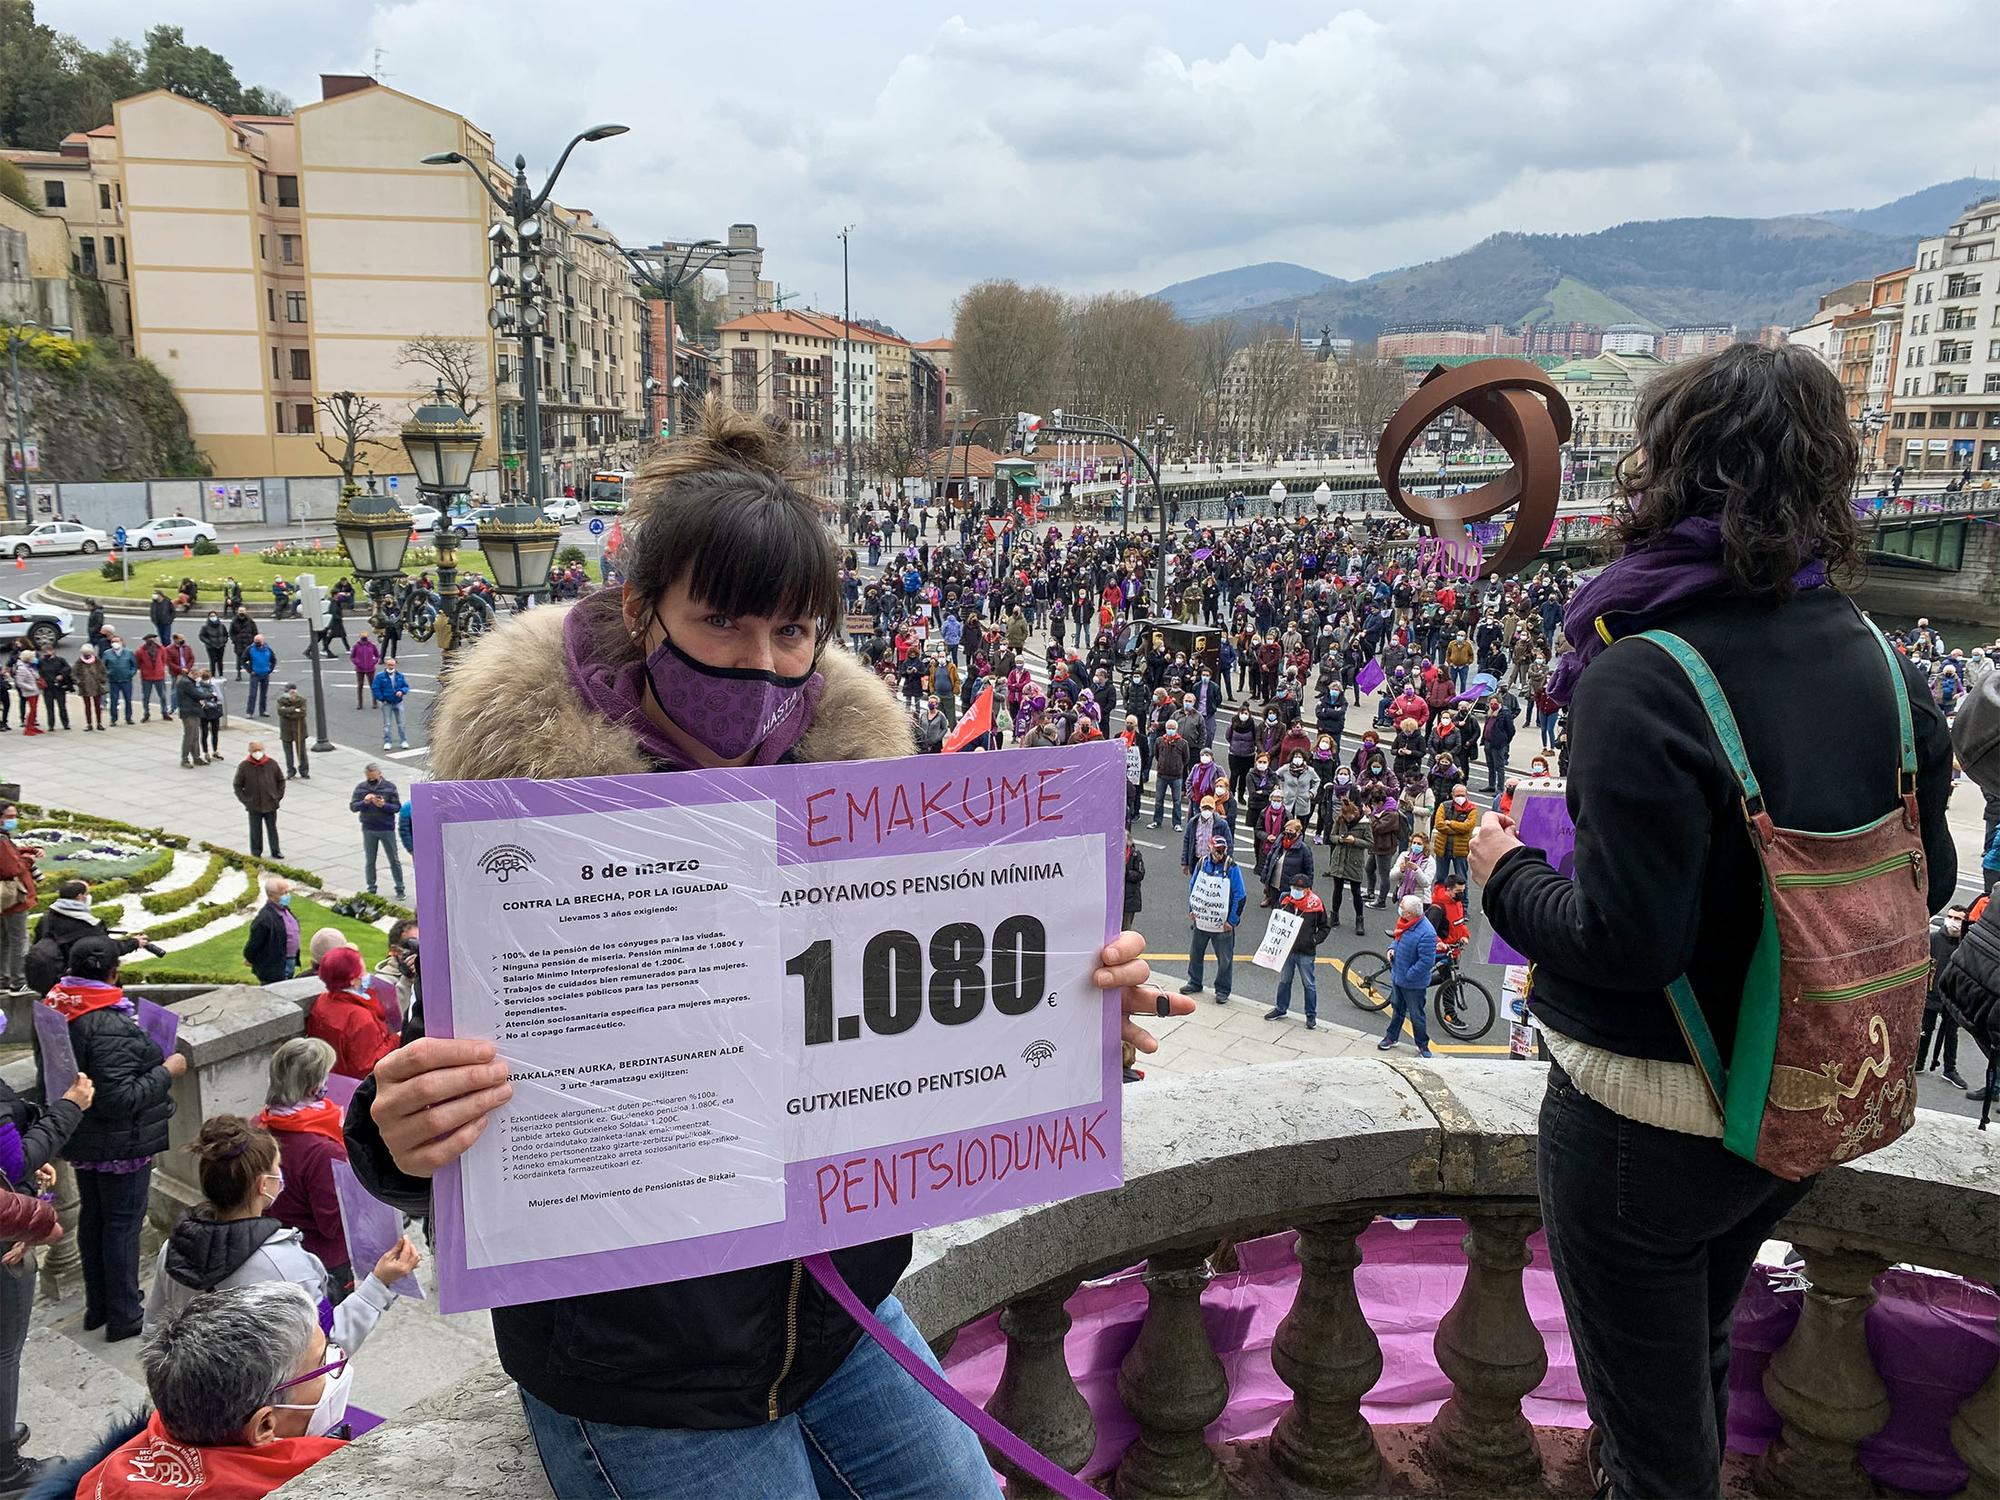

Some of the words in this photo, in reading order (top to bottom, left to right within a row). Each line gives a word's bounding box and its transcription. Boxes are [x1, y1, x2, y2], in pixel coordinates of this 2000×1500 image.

[762, 691, 797, 736] HASTA
[806, 768, 1064, 847] EMAKUME
[581, 865, 594, 880] 8
[601, 863, 627, 879] de
[635, 859, 700, 875] marzo
[503, 899, 552, 911] CONTRA
[556, 897, 570, 906] LA
[574, 892, 624, 904] BRECHA,
[628, 889, 651, 900] POR
[655, 888, 668, 897] LA
[672, 883, 728, 895] IGUALDAD
[779, 878, 896, 908] APOYAMOS
[902, 868, 985, 895] PENSIÓN
[991, 862, 1064, 886] MÍNIMA
[559, 912, 600, 923] Llevamos
[603, 911, 609, 919] 3
[611, 909, 631, 918] años
[634, 905, 678, 917] exigiendo:
[502, 951, 526, 960] 100%
[553, 945, 587, 957] pensión
[618, 938, 659, 950] cónyuges
[661, 936, 680, 945] para
[696, 931, 726, 940] viudas.
[502, 962, 539, 972] Ninguna
[541, 957, 576, 969] pensión
[591, 952, 626, 962] miseria.
[628, 948, 662, 958] Pensión
[664, 944, 694, 954] mínima
[697, 943, 707, 951] de
[709, 940, 737, 949] 1.080€
[739, 940, 744, 948] y
[503, 973, 534, 983] Salario
[537, 970, 568, 979] Mínimo
[571, 962, 639, 977] Interprofesional
[654, 957, 685, 967] 1.200€.
[503, 984, 542, 994] Trabajos
[558, 978, 597, 988] cuidados
[600, 976, 618, 984] bien
[620, 969, 675, 982] remunerados
[678, 967, 696, 977] para
[713, 961, 748, 972] mujeres.
[504, 996, 545, 1006] Servicios
[548, 991, 584, 1001] sociales
[586, 986, 622, 997] públicos
[625, 984, 644, 993] para
[661, 978, 699, 990] personas
[504, 1005, 567, 1018] dependientes.
[505, 1018, 545, 1028] Atención
[547, 1011, 609, 1025] sociosanitaria
[611, 1006, 655, 1017] específica
[657, 1003, 676, 1013] para
[678, 999, 711, 1009] mujeres
[713, 994, 750, 1005] mayores.
[506, 1032, 518, 1040] No
[531, 1027, 563, 1038] copago
[566, 1021, 626, 1033] farmacéutico.
[506, 1067, 575, 1082] RRAKALAREN
[578, 1063, 616, 1075] AURKA,
[619, 1049, 717, 1069] BERDINTASUNAREN
[719, 1045, 744, 1056] ALDE
[560, 1083, 566, 1091] 3
[568, 1081, 587, 1090] urte
[786, 1080, 911, 1115] GUTXIENEKO
[917, 1063, 1007, 1094] PENTSIOA
[510, 1112, 559, 1124] Ezkontideek
[617, 1102, 640, 1111] duten
[511, 1123, 552, 1134] Miseriazko
[555, 1116, 594, 1129] pentsiorik
[597, 1115, 607, 1123] ez.
[722, 1097, 734, 1105] eta
[511, 1132, 542, 1143] Lanbide
[545, 1129, 570, 1139] arteko
[573, 1123, 617, 1136] Gutxieneko
[816, 1109, 1108, 1224] PENTSIODUNAK
[528, 1196, 563, 1208] Mujeres
[565, 1194, 578, 1203] del
[580, 1187, 631, 1202] Movimiento
[633, 1186, 643, 1194] de
[645, 1178, 694, 1193] Pensionistas
[696, 1176, 707, 1184] de
[708, 1171, 736, 1182] Bizkaia
